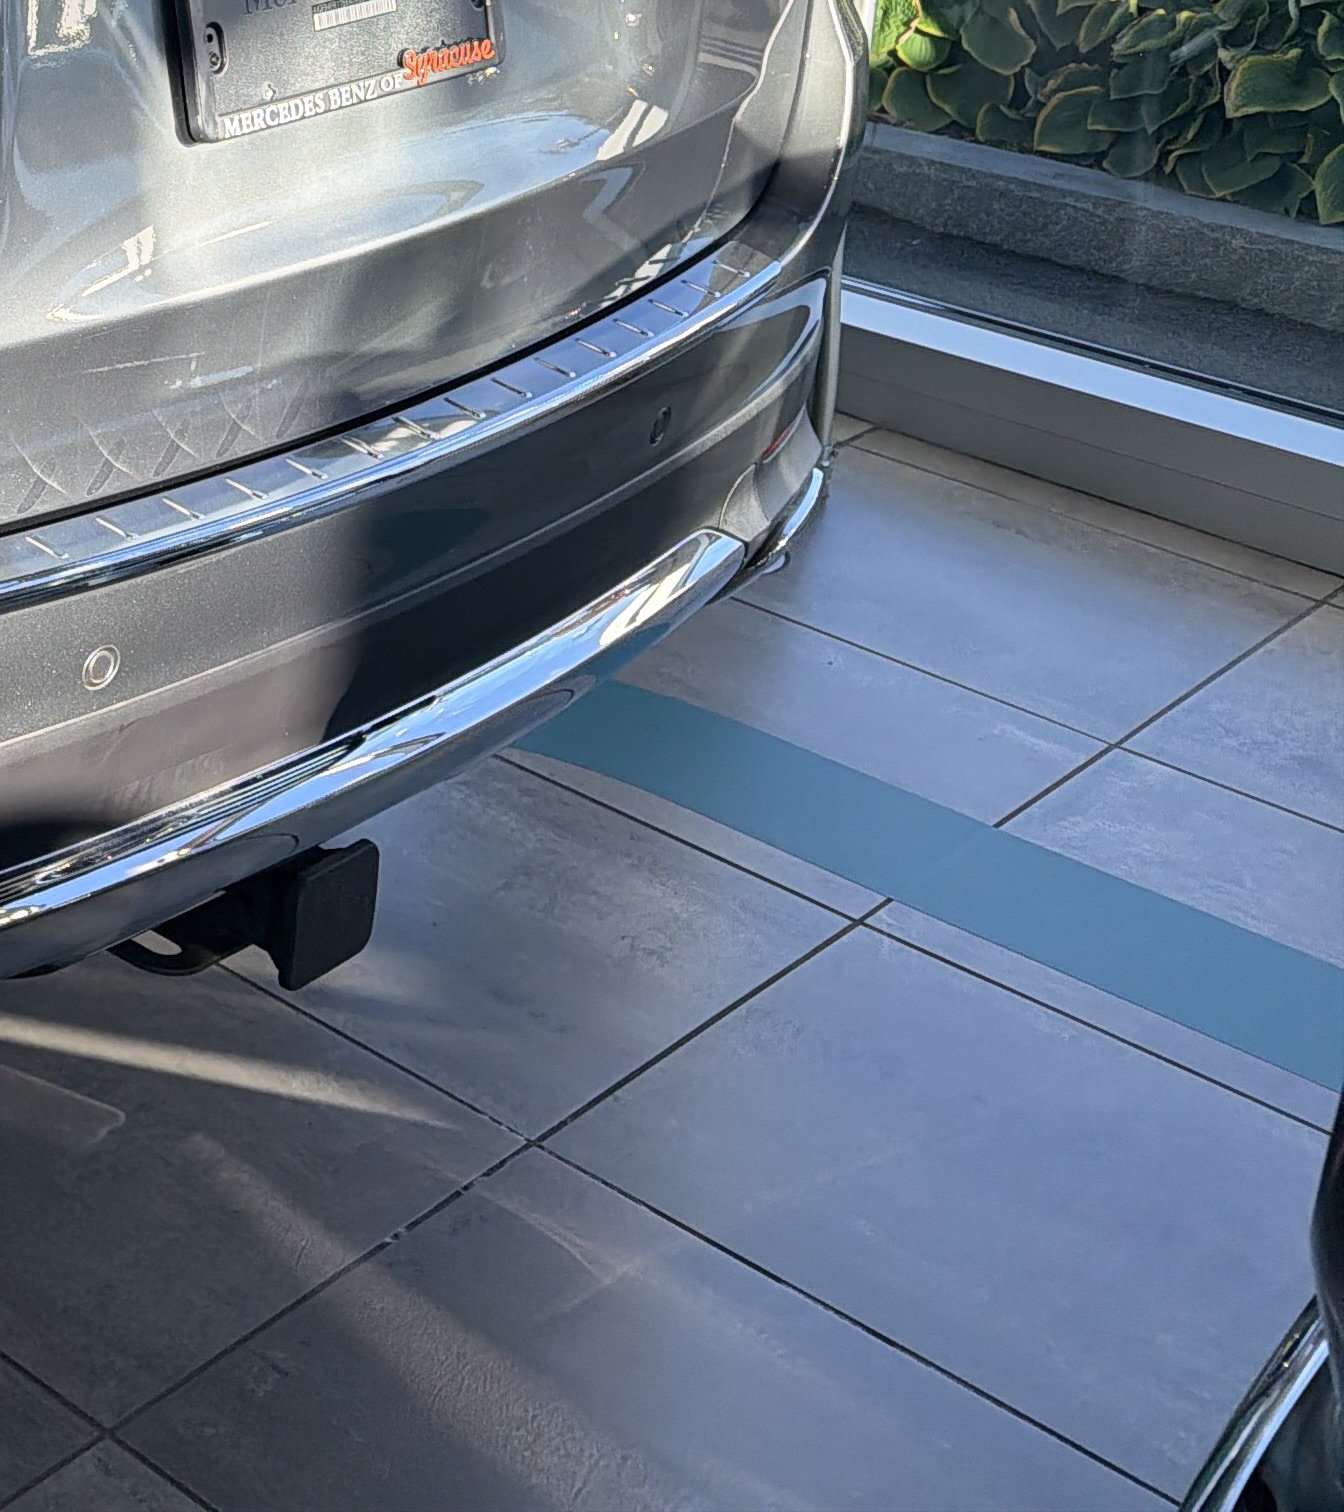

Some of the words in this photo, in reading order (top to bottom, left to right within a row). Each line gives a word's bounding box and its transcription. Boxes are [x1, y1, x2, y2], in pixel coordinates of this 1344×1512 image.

[223, 95, 326, 139] MERCEDES
[328, 79, 379, 111] BENZ
[379, 73, 404, 94] OF
[403, 38, 496, 86] Syracuse
